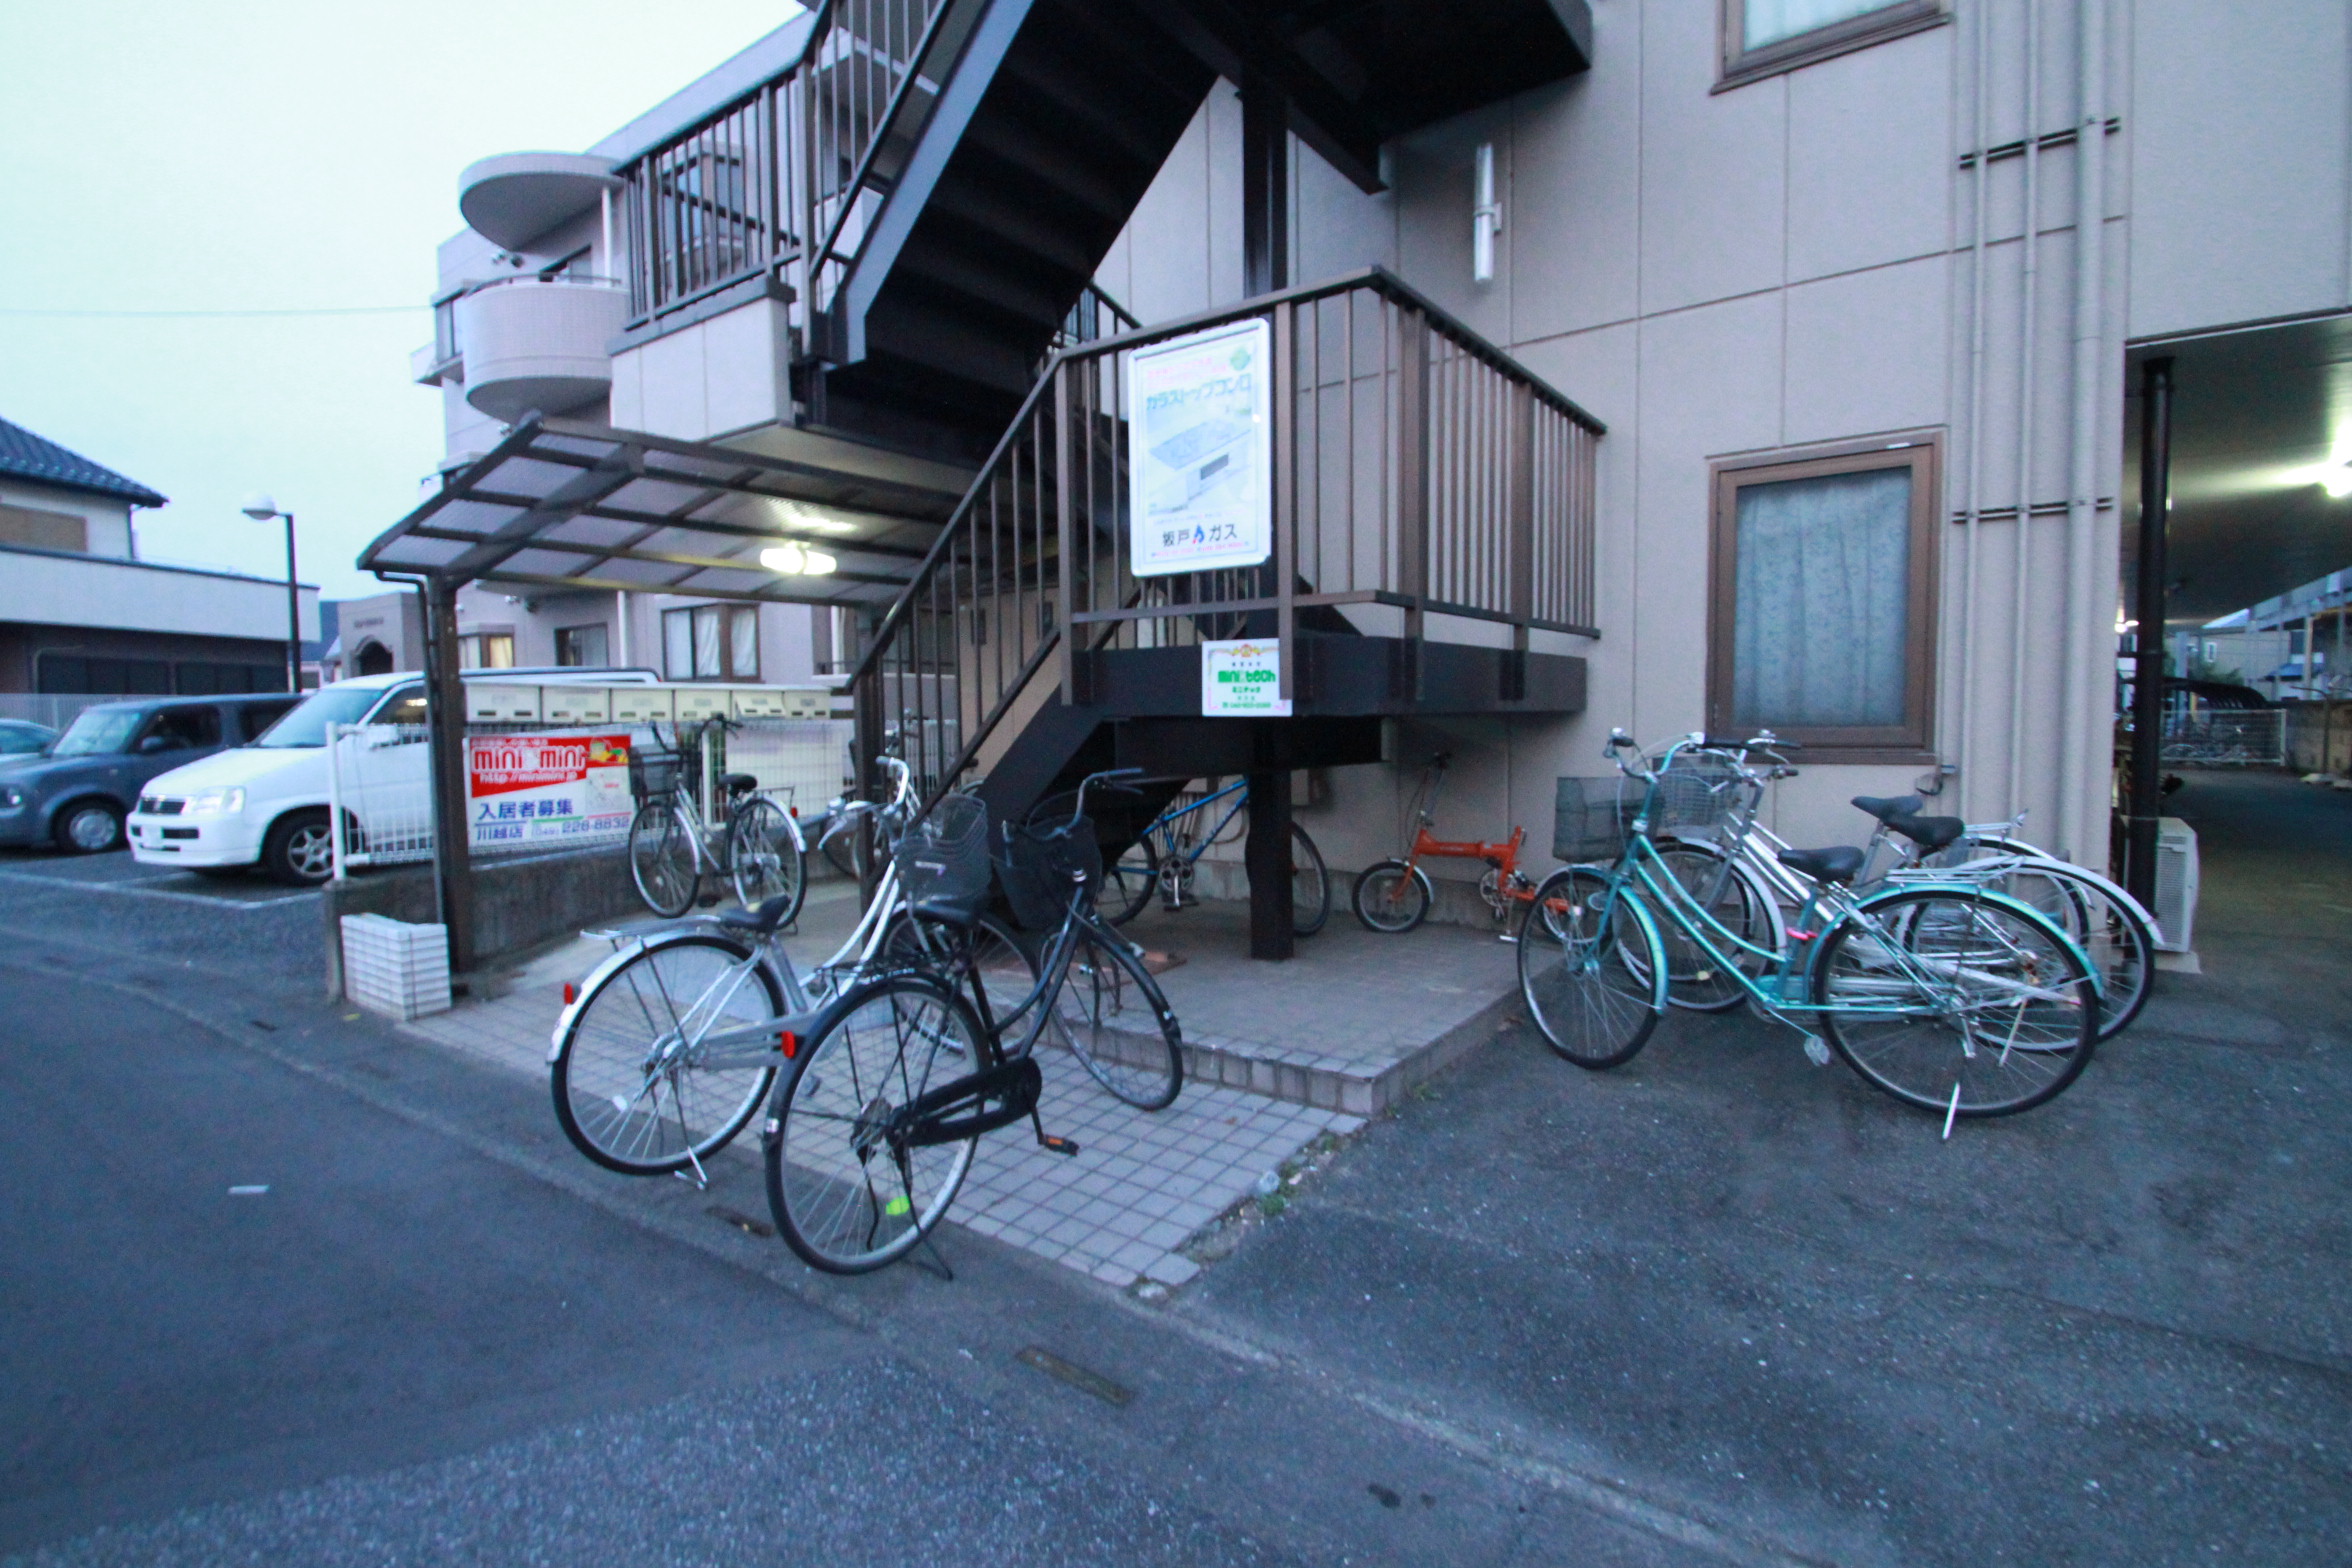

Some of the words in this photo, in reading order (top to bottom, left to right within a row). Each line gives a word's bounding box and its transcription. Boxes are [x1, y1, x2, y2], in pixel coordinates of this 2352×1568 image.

[1209, 524, 1238, 542] ガス
[478, 798, 574, 820] 入居者募集
[477, 825, 524, 841] 川越店
